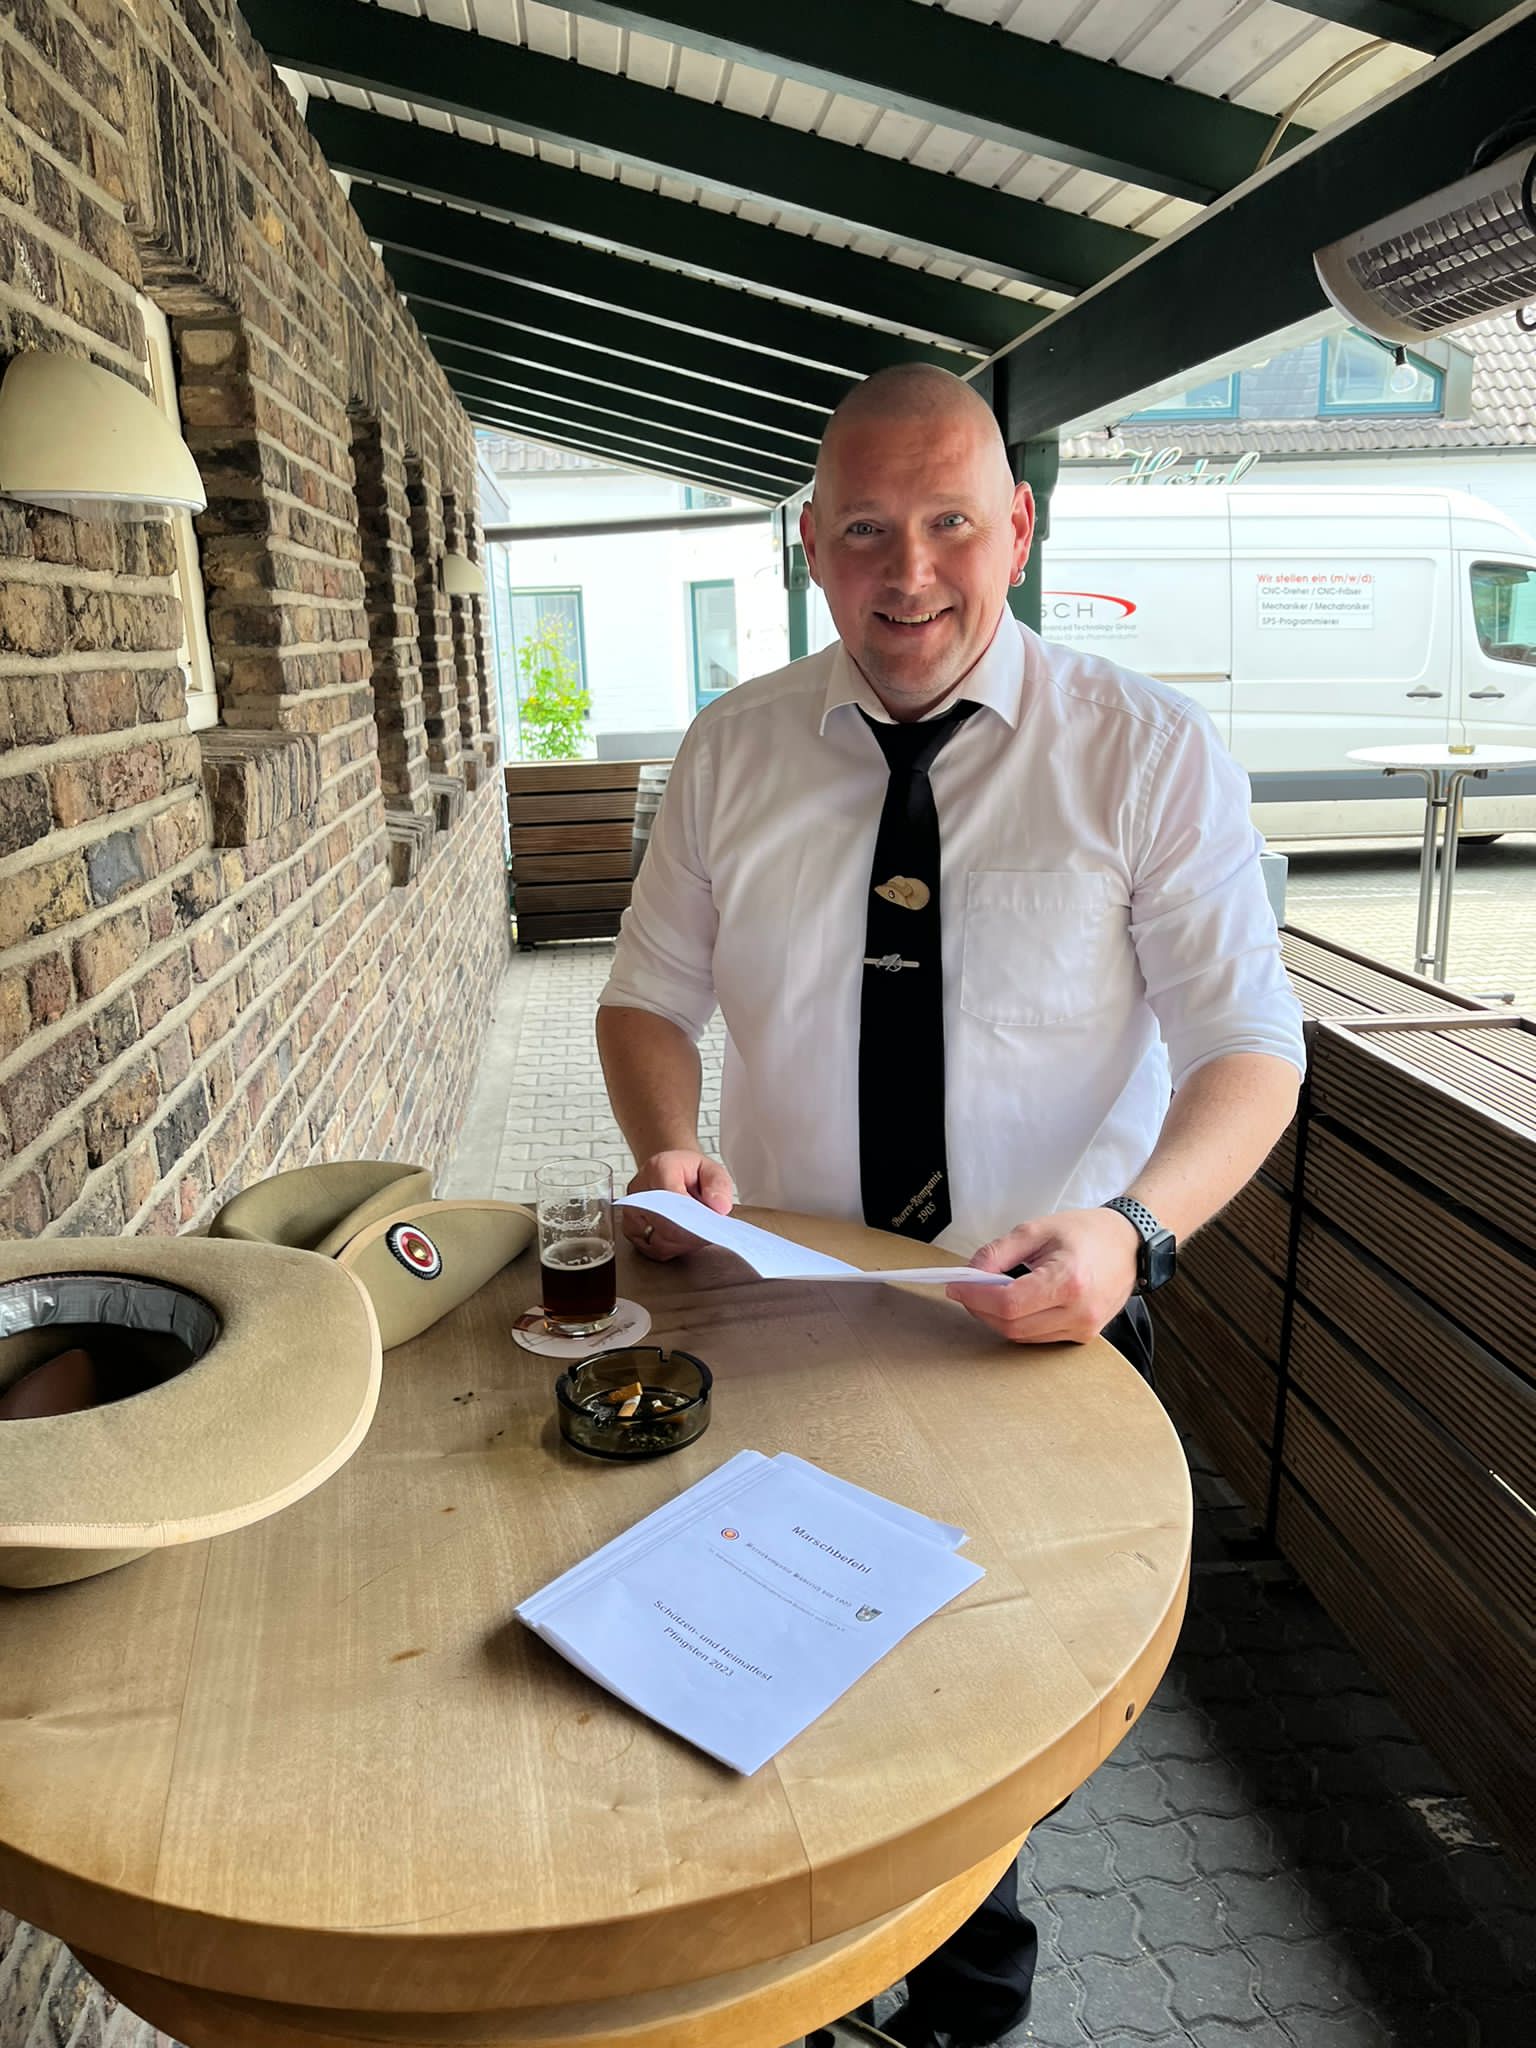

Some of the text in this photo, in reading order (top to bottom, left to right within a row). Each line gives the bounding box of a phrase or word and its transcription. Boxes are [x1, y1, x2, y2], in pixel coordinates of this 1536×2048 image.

[1257, 574, 1272, 584] Wir
[1275, 573, 1308, 584] stellen
[1311, 573, 1327, 584] ein
[1261, 601, 1308, 611] Mechaniker
[791, 1525, 873, 1575] Marschbefehl
[699, 1633, 721, 1649] und
